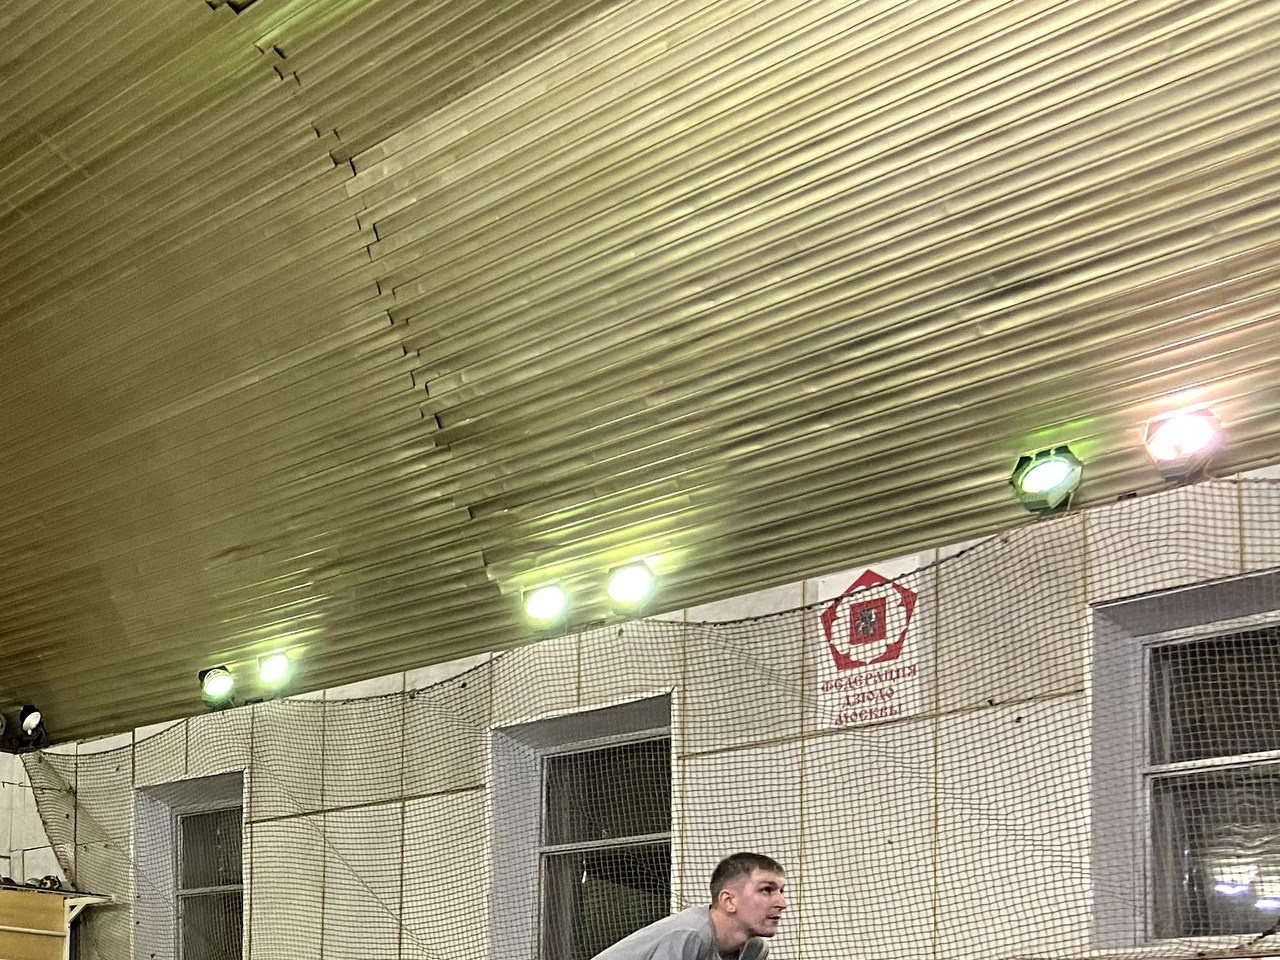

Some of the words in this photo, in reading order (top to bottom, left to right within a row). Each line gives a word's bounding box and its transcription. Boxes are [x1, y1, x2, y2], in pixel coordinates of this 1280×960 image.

[821, 664, 917, 692] ФЕДЕРАЦИЯ
[842, 687, 895, 708] ДЗЮДО
[835, 704, 902, 726] МОСКВЫ
